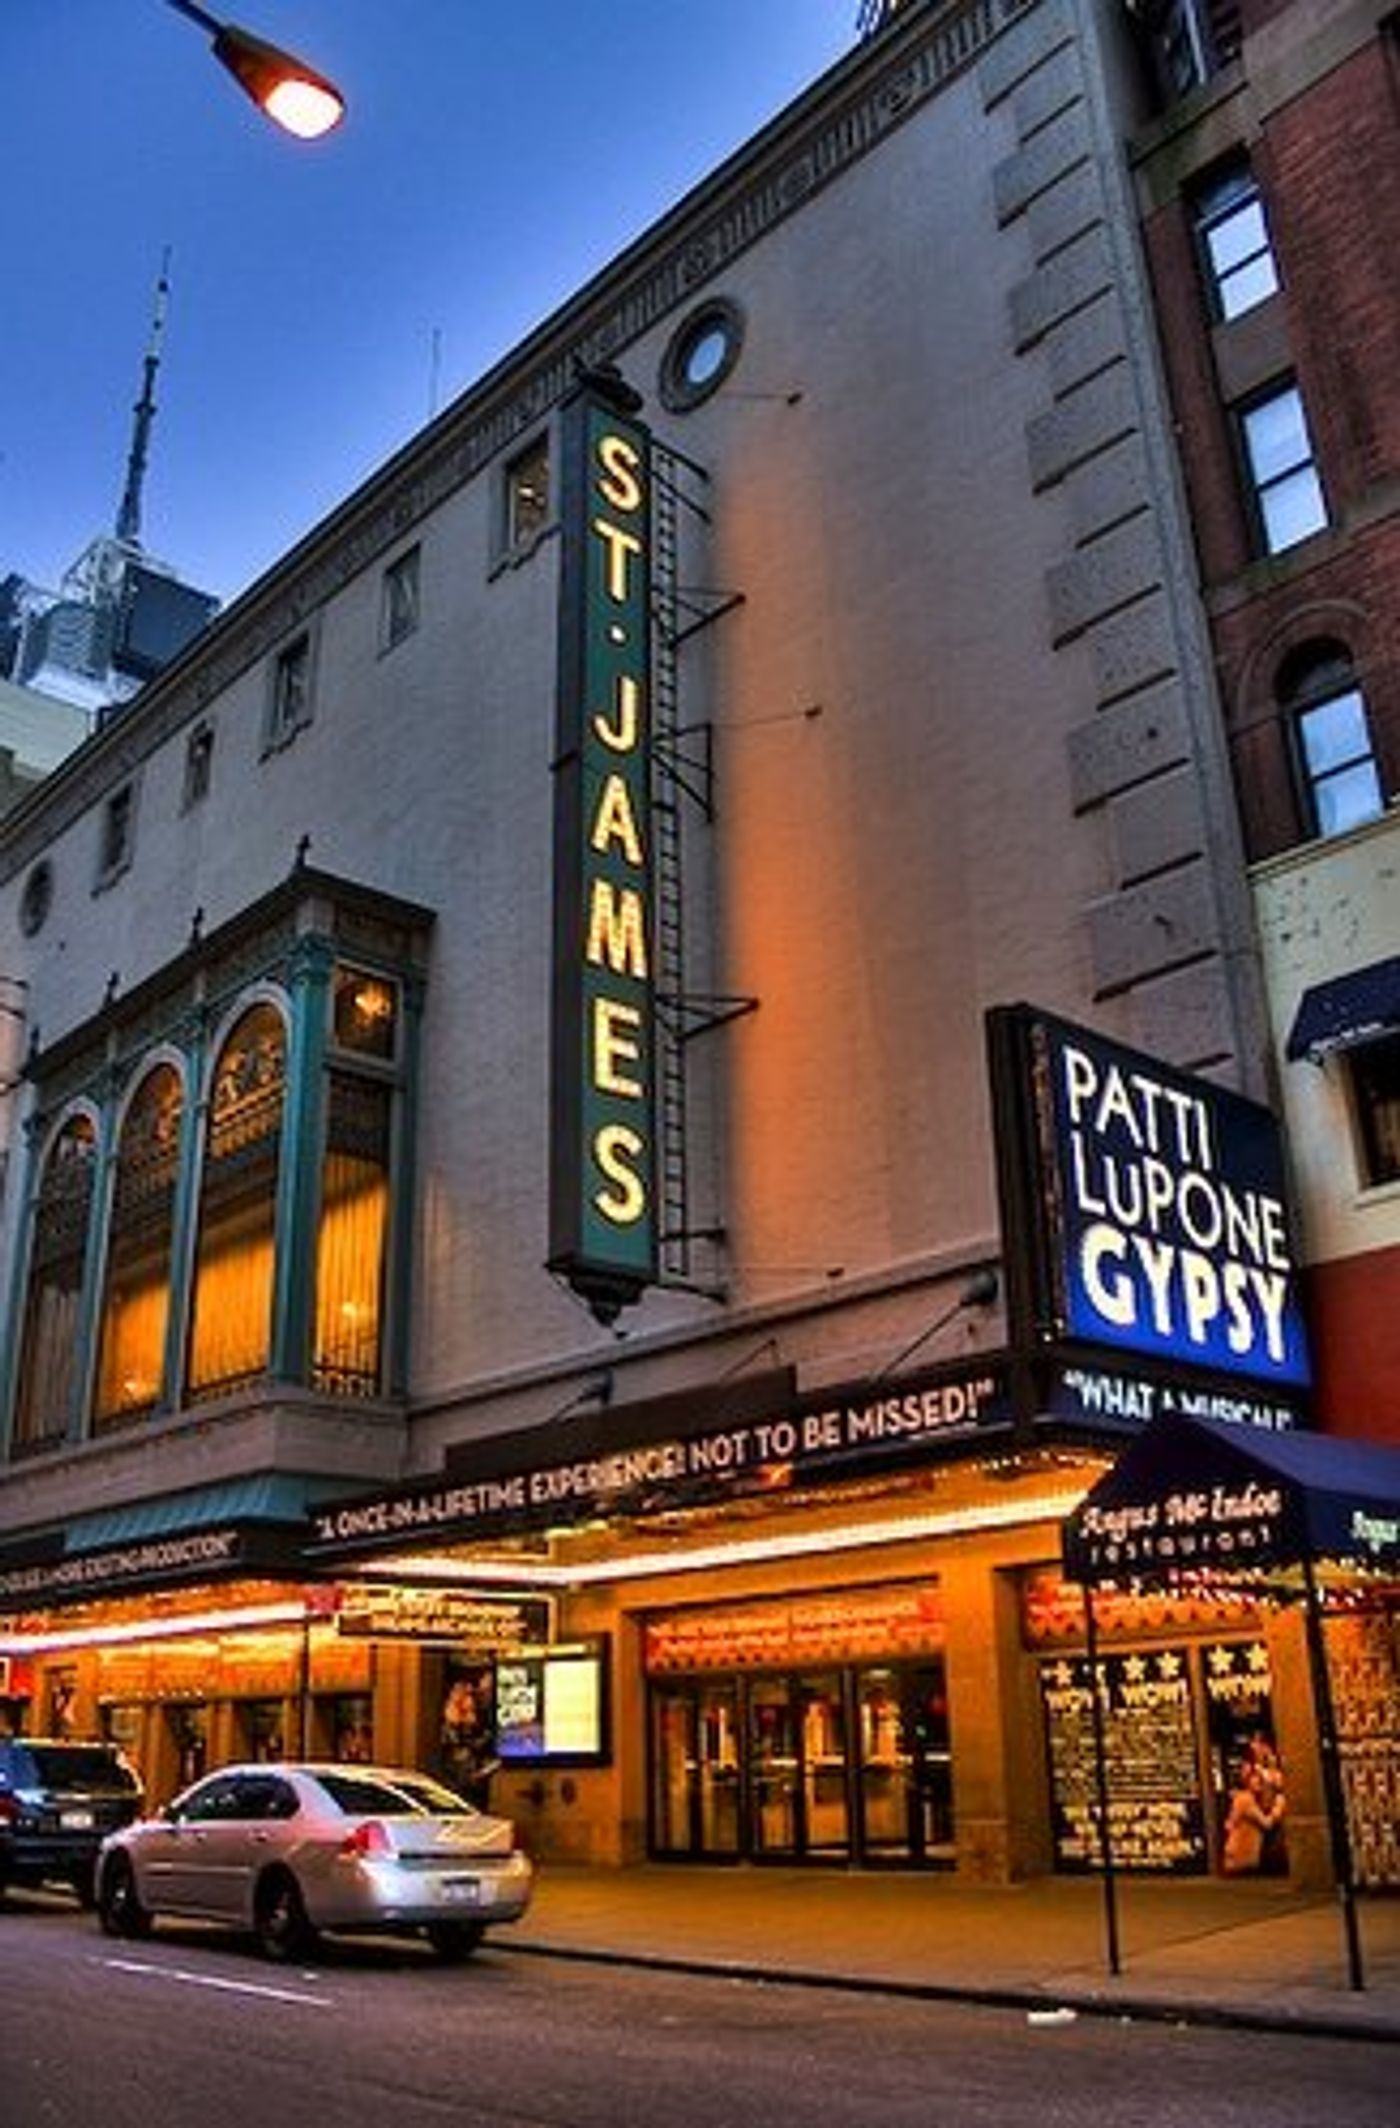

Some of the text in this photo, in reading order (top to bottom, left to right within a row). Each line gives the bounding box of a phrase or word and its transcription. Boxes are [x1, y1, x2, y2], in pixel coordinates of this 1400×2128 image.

[585, 676, 649, 1223] JAMES
[1062, 1046, 1212, 1170] PATTI
[1071, 1130, 1290, 1270] LUPONE
[1080, 1225, 1287, 1363] GYPSY
[689, 1428, 750, 1471] NOT
[754, 1422, 796, 1458] TO
[803, 1412, 841, 1449] BE
[1090, 1524, 1272, 1565] restaurant
